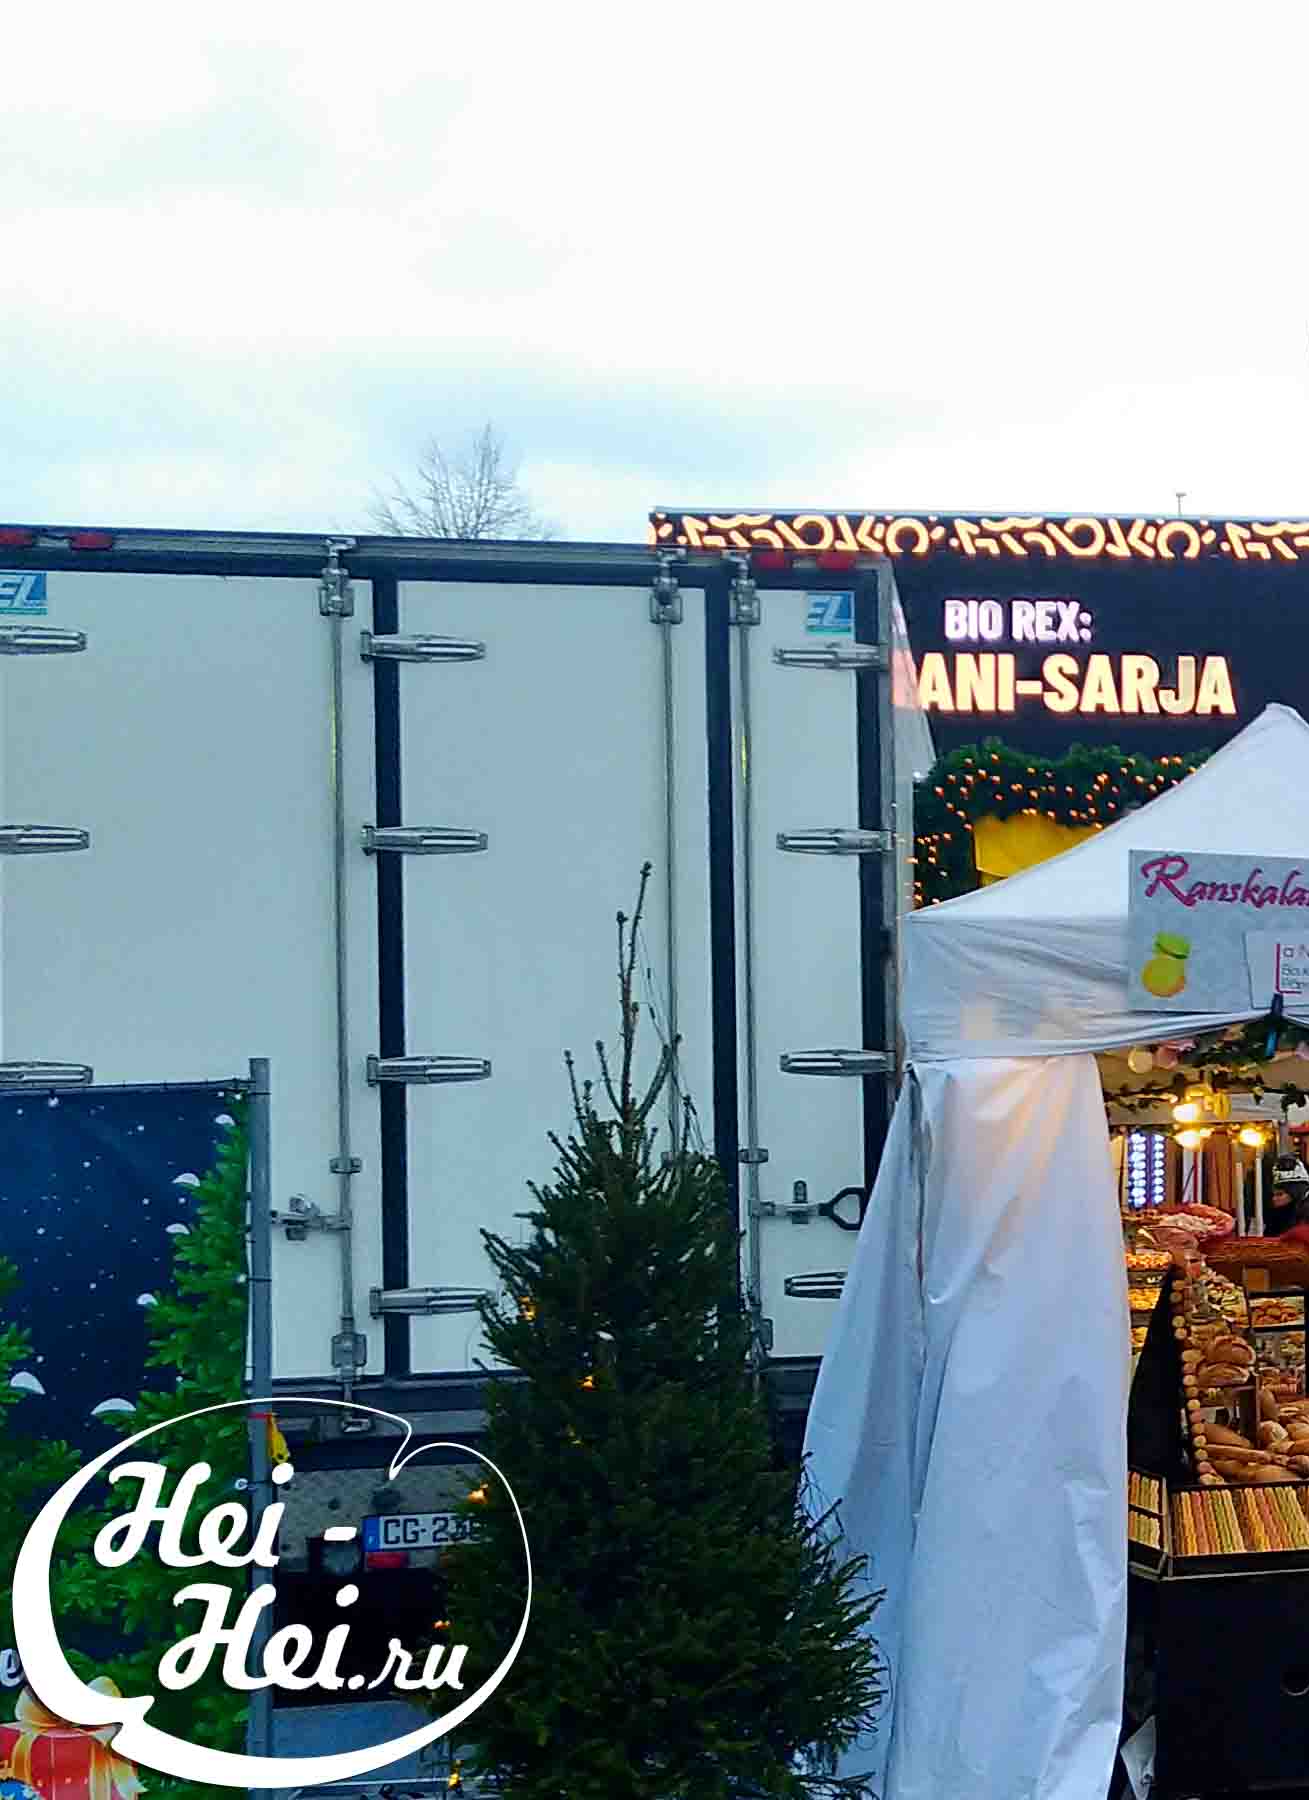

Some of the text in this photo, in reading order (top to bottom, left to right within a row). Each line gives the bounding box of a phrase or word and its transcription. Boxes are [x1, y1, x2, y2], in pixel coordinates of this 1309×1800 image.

[944, 600, 1092, 642] BIO REX:
[918, 652, 1237, 715] ANI-SARJA
